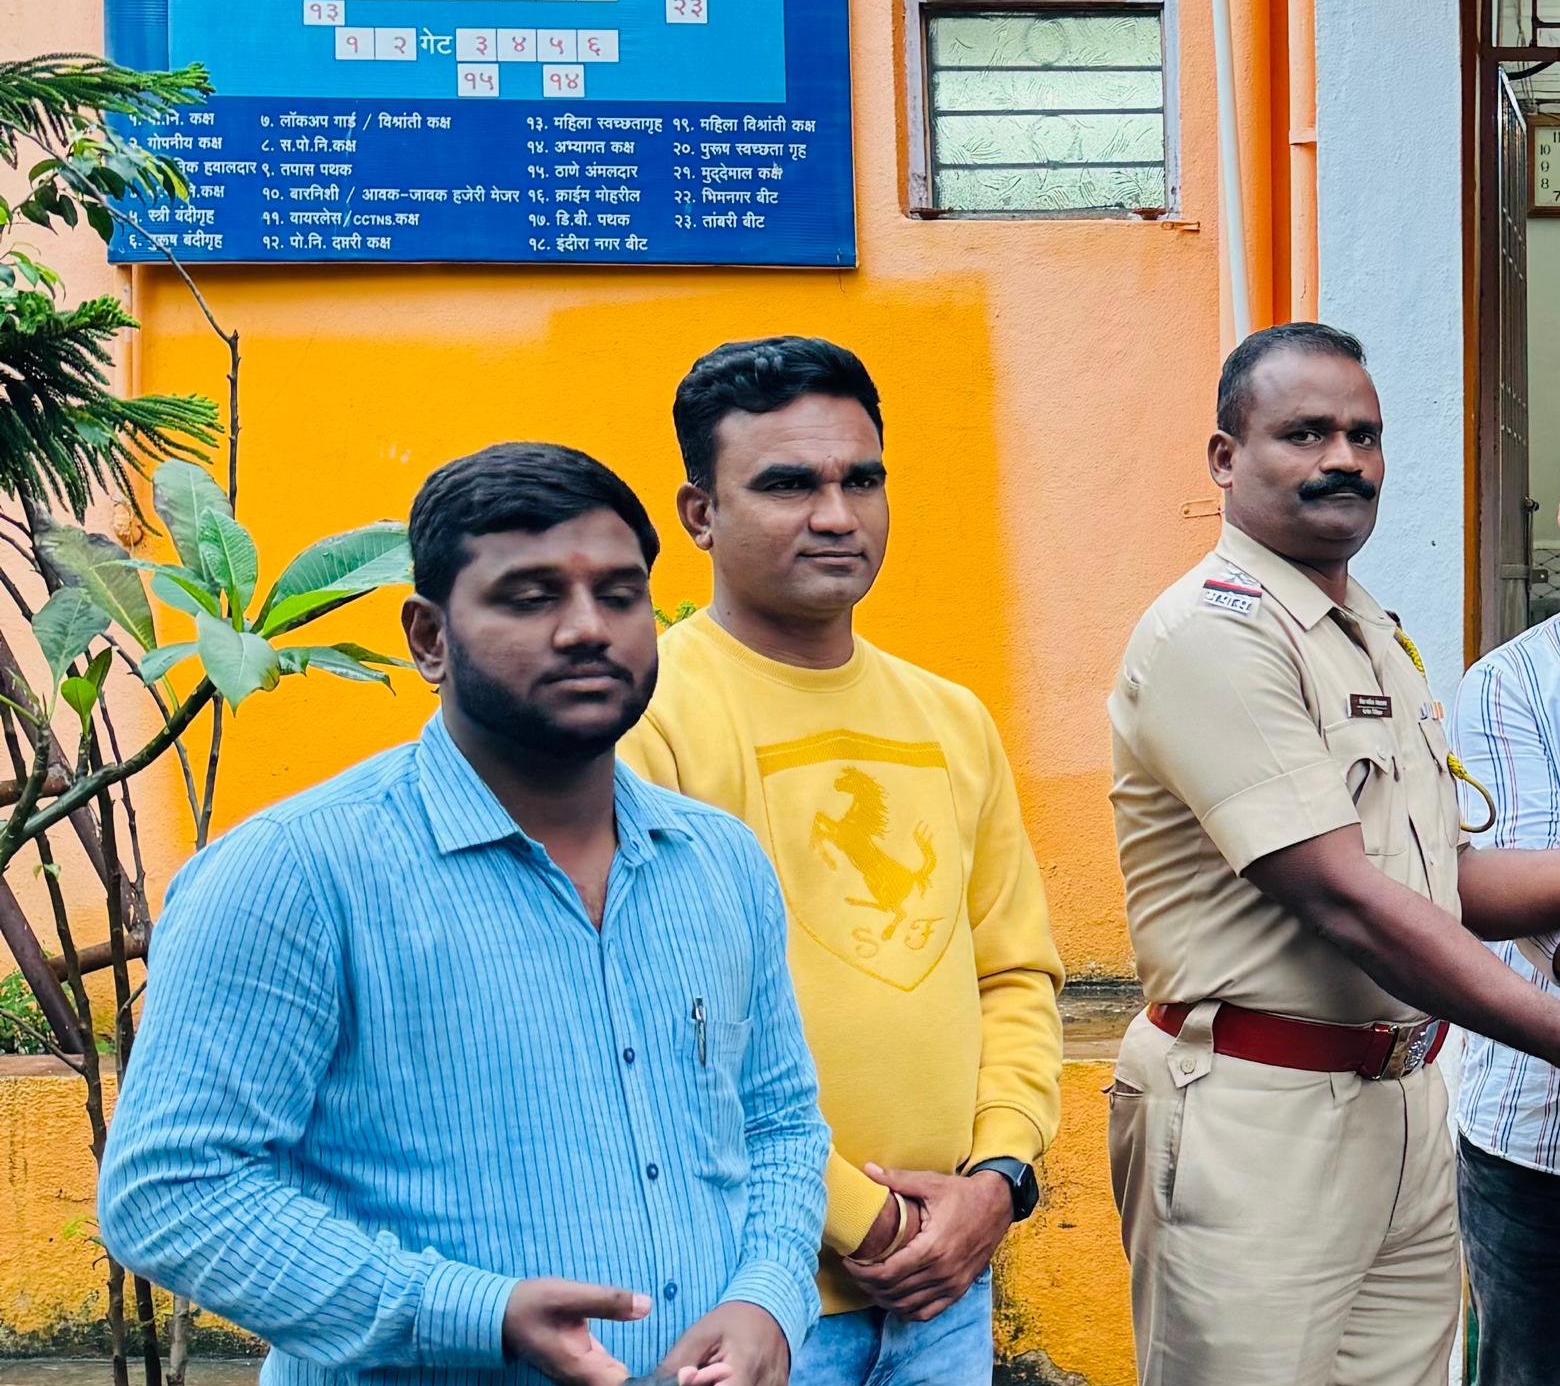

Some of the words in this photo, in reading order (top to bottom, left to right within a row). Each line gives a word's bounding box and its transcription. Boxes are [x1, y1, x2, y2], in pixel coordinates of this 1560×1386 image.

[310, 3, 339, 22] १३
[346, 36, 358, 53] १
[393, 36, 406, 54] २
[420, 27, 453, 55] गेट
[475, 36, 488, 55] ३
[512, 36, 526, 52] ४
[549, 36, 564, 55] ५
[588, 37, 601, 56] ६
[464, 72, 494, 91] १५
[549, 73, 579, 91] १४
[189, 112, 215, 125] कक्ष
[260, 115, 274, 127] ७.
[280, 111, 328, 128] लॉकअप
[378, 112, 422, 129] विश्रांती
[427, 116, 451, 129] कक्ष
[526, 116, 548, 132] १३.
[553, 112, 592, 132] महिला
[597, 117, 662, 134] स्वच्छतागृह
[672, 118, 694, 133] १९.
[699, 114, 738, 133] महिला
[743, 115, 786, 132] विश्रांती
[791, 120, 816, 132] कक्ष
[147, 132, 193, 149] गोपनीय
[198, 136, 223, 150] कक्ष
[261, 139, 275, 152] ८.
[1553, 131, 1560, 143] 11
[527, 140, 549, 154] १४.
[610, 141, 635, 154] कक्ष
[673, 142, 695, 156] २०.
[735, 143, 784, 156] स्वच्छता
[788, 143, 807, 161] गृह
[1540, 144, 1551, 156] 10
[203, 161, 257, 176] हवालदार
[261, 163, 275, 178] ९.
[280, 163, 315, 177] तपास
[320, 163, 352, 177] पथक
[527, 165, 549, 179] १५.
[554, 161, 580, 178] ठाणे
[585, 161, 638, 180] अंमलदार
[673, 166, 696, 180] २१.
[1540, 178, 1549, 189] 8
[262, 187, 284, 202] १०.
[452, 185, 485, 204] हजेरी
[490, 186, 520, 203] मेजर
[528, 189, 549, 204] १६.
[555, 185, 590, 204] क्राईम
[595, 185, 641, 204] मोहरील
[674, 190, 696, 204] २२.
[701, 186, 751, 204] भिमनगर
[148, 205, 170, 222] स्त्री
[262, 211, 284, 226] ११.
[528, 213, 550, 227] १७.
[597, 213, 631, 226] पथक
[674, 214, 697, 229] २३.
[262, 235, 284, 250] १२.
[367, 236, 391, 250] कक्ष
[528, 237, 551, 251] १८.
[594, 237, 620, 251] नगर
[851, 928, 880, 960] S
